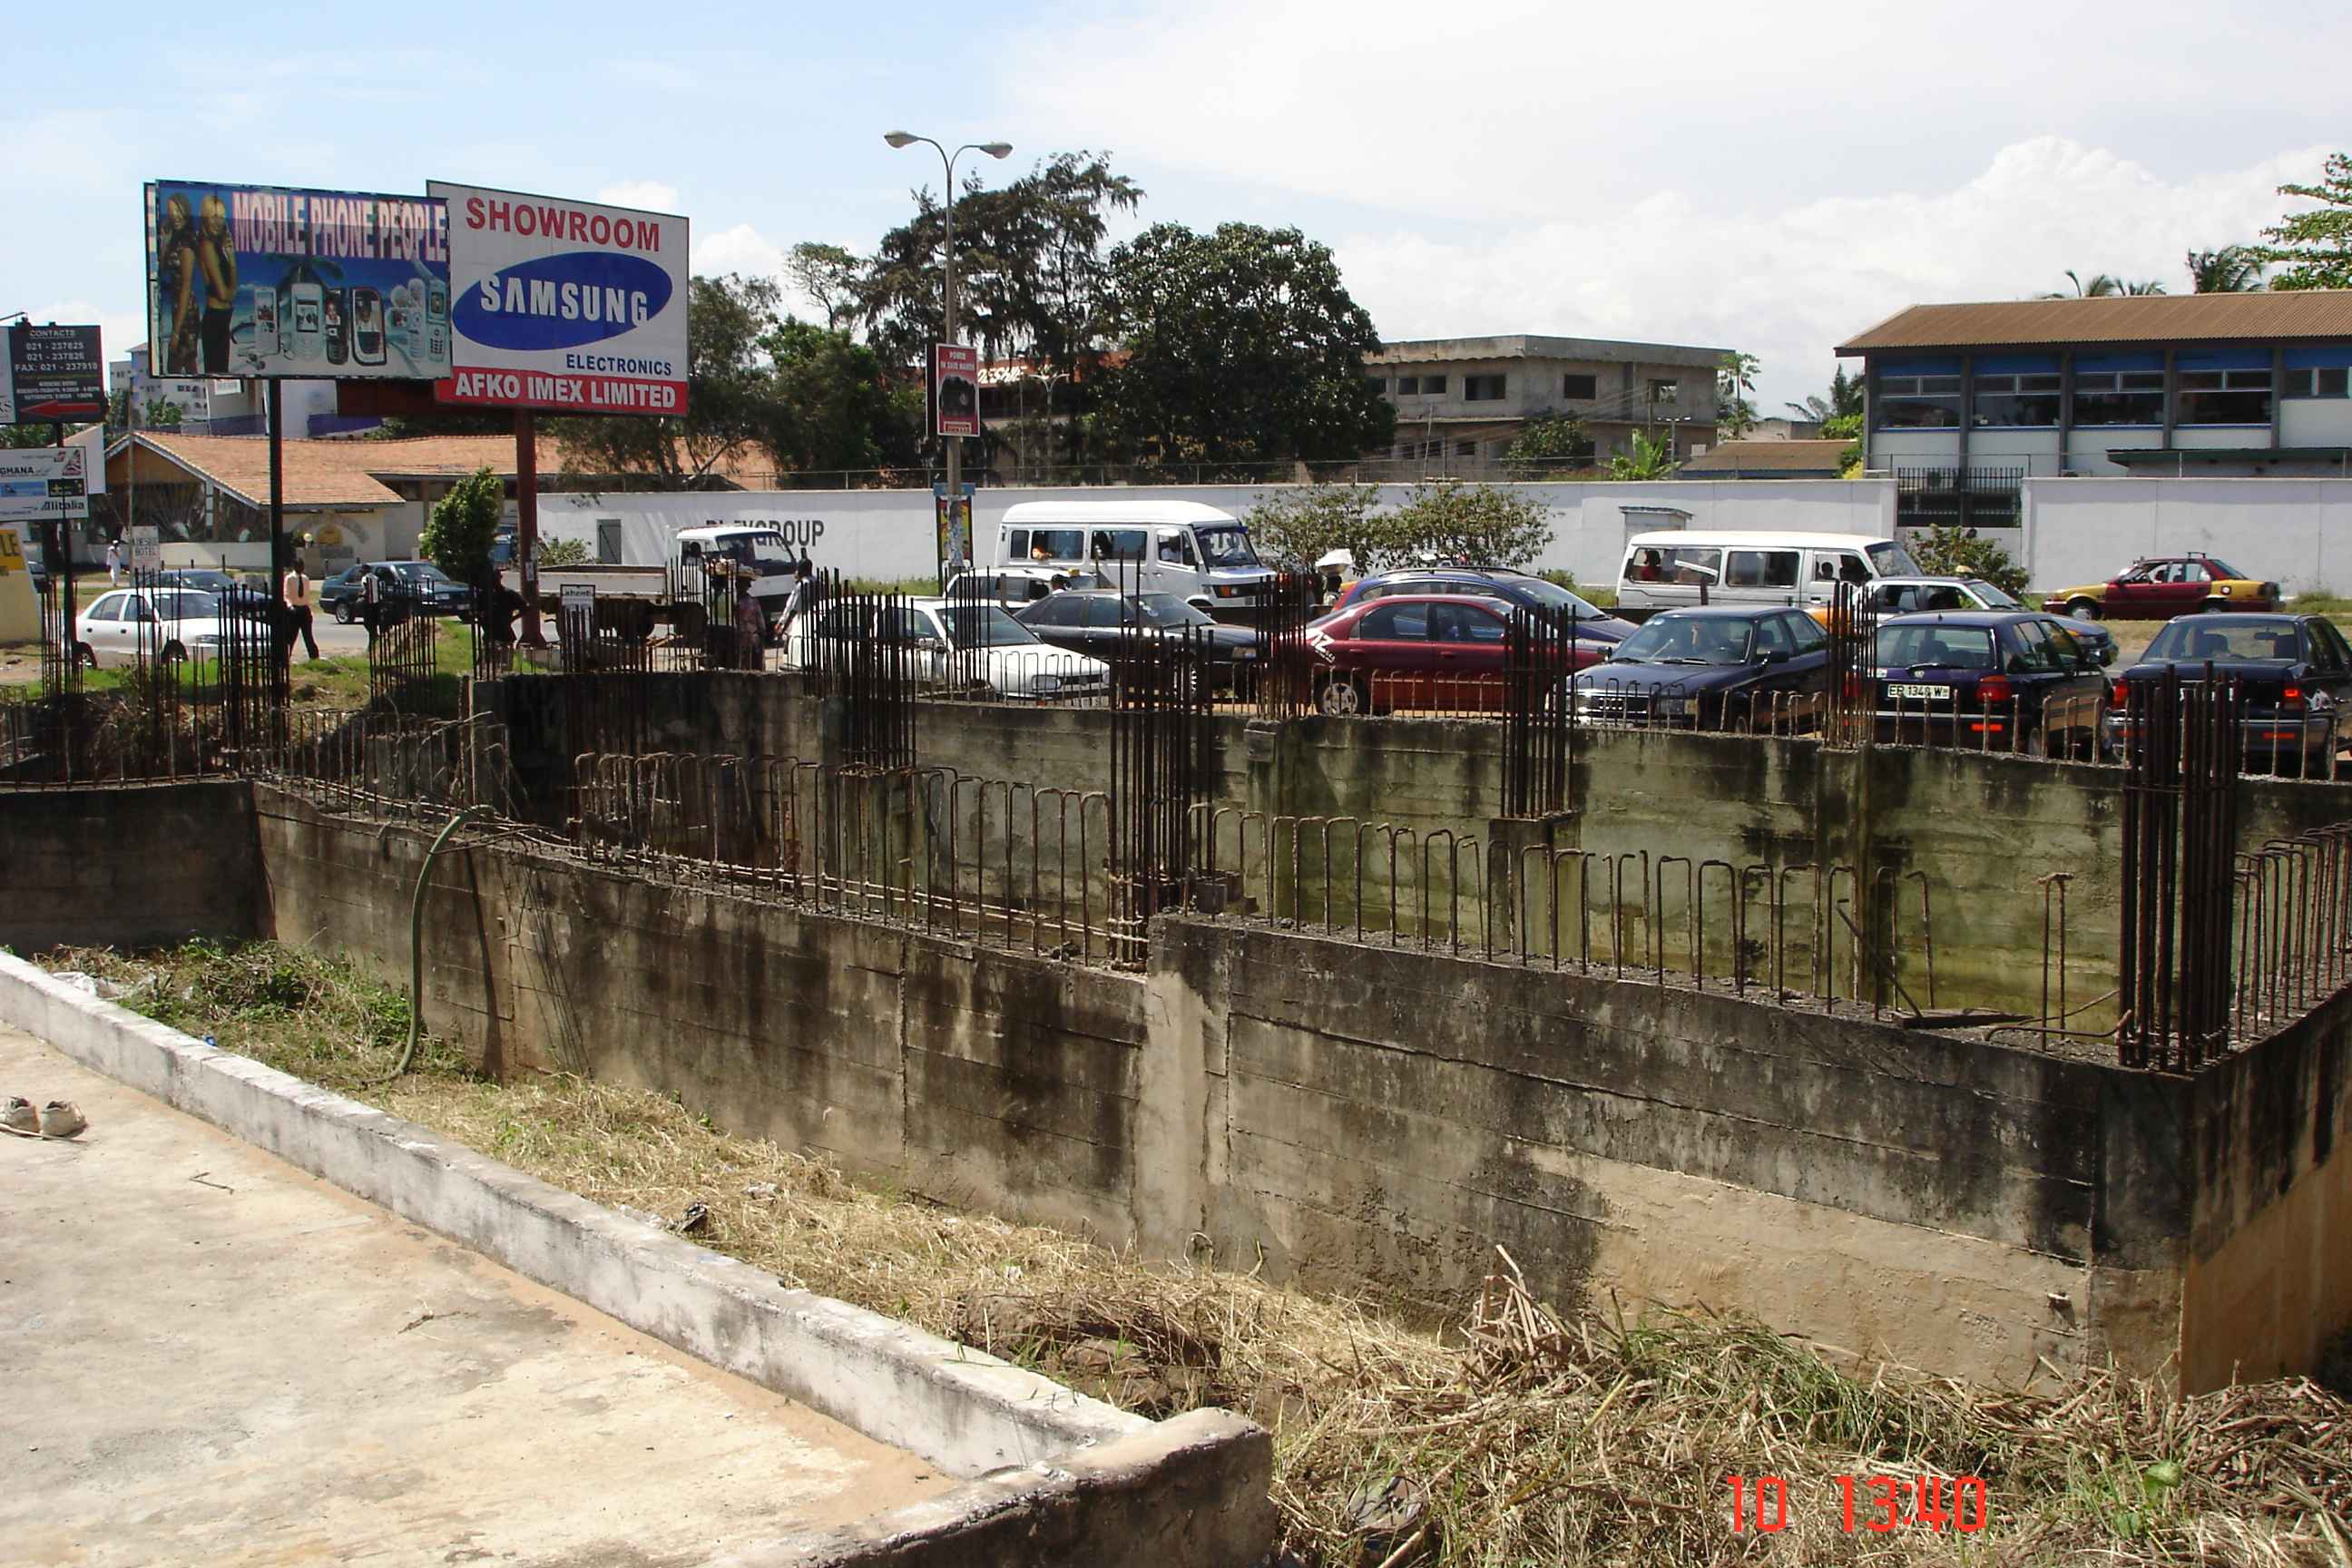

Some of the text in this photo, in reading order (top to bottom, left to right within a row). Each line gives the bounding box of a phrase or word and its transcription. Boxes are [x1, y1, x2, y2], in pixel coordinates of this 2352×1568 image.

[232, 191, 447, 262] MOBILE PHONE PEOPLE
[466, 197, 660, 252] SHOWROOM
[480, 274, 648, 328] SAMSUNG
[566, 354, 672, 377] ELECTRONICS
[456, 373, 676, 407] AFKO IMEX LIMITED
[706, 519, 825, 547] GROUP
